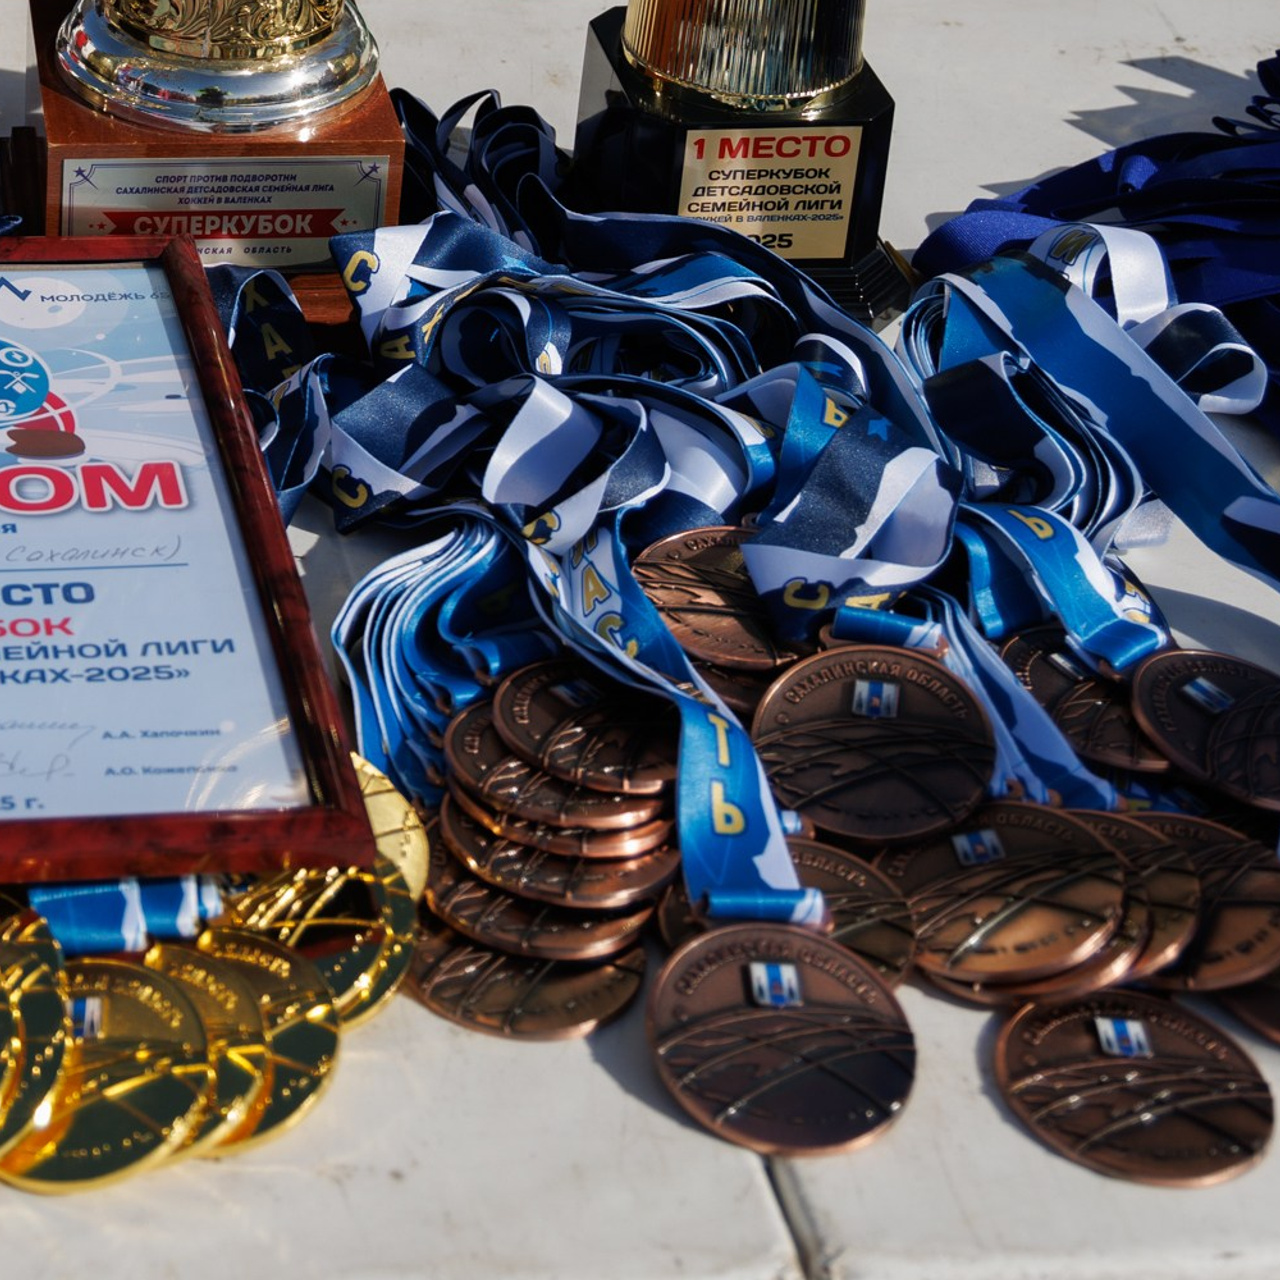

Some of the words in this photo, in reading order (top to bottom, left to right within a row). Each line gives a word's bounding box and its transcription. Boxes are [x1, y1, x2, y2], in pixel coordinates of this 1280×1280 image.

[693, 138, 706, 160] 1
[717, 135, 852, 159] МЕСТО
[154, 175, 188, 184] СПОРТ
[189, 174, 228, 184] ПРОТИВ
[708, 168, 831, 181] СУПЕРКУБОК
[115, 186, 186, 195] САХАЛИНСКАЯ
[186, 185, 260, 195] ДЕТСАДОВСКАЯ
[261, 183, 311, 193] СЕМЕЙНАЯ
[311, 184, 335, 193] ЛИГА
[692, 181, 842, 197] ДЕТСАДОВСКОЙ
[177, 195, 215, 206] ХОККЕЙ
[225, 195, 273, 205] ВАЛЕНКАХ
[687, 198, 790, 213] СЕМЕЙНОЙ
[793, 199, 843, 211] ЛИГИ
[132, 213, 313, 237] СУПЕРКУБОК
[243, 245, 293, 255] ОБЛАСТЬ
[39, 292, 146, 303] МОЛОДЁЖЬ
[140, 636, 235, 658] ЛИГИ
[784, 661, 902, 704] САХАЛИНСКАЯ
